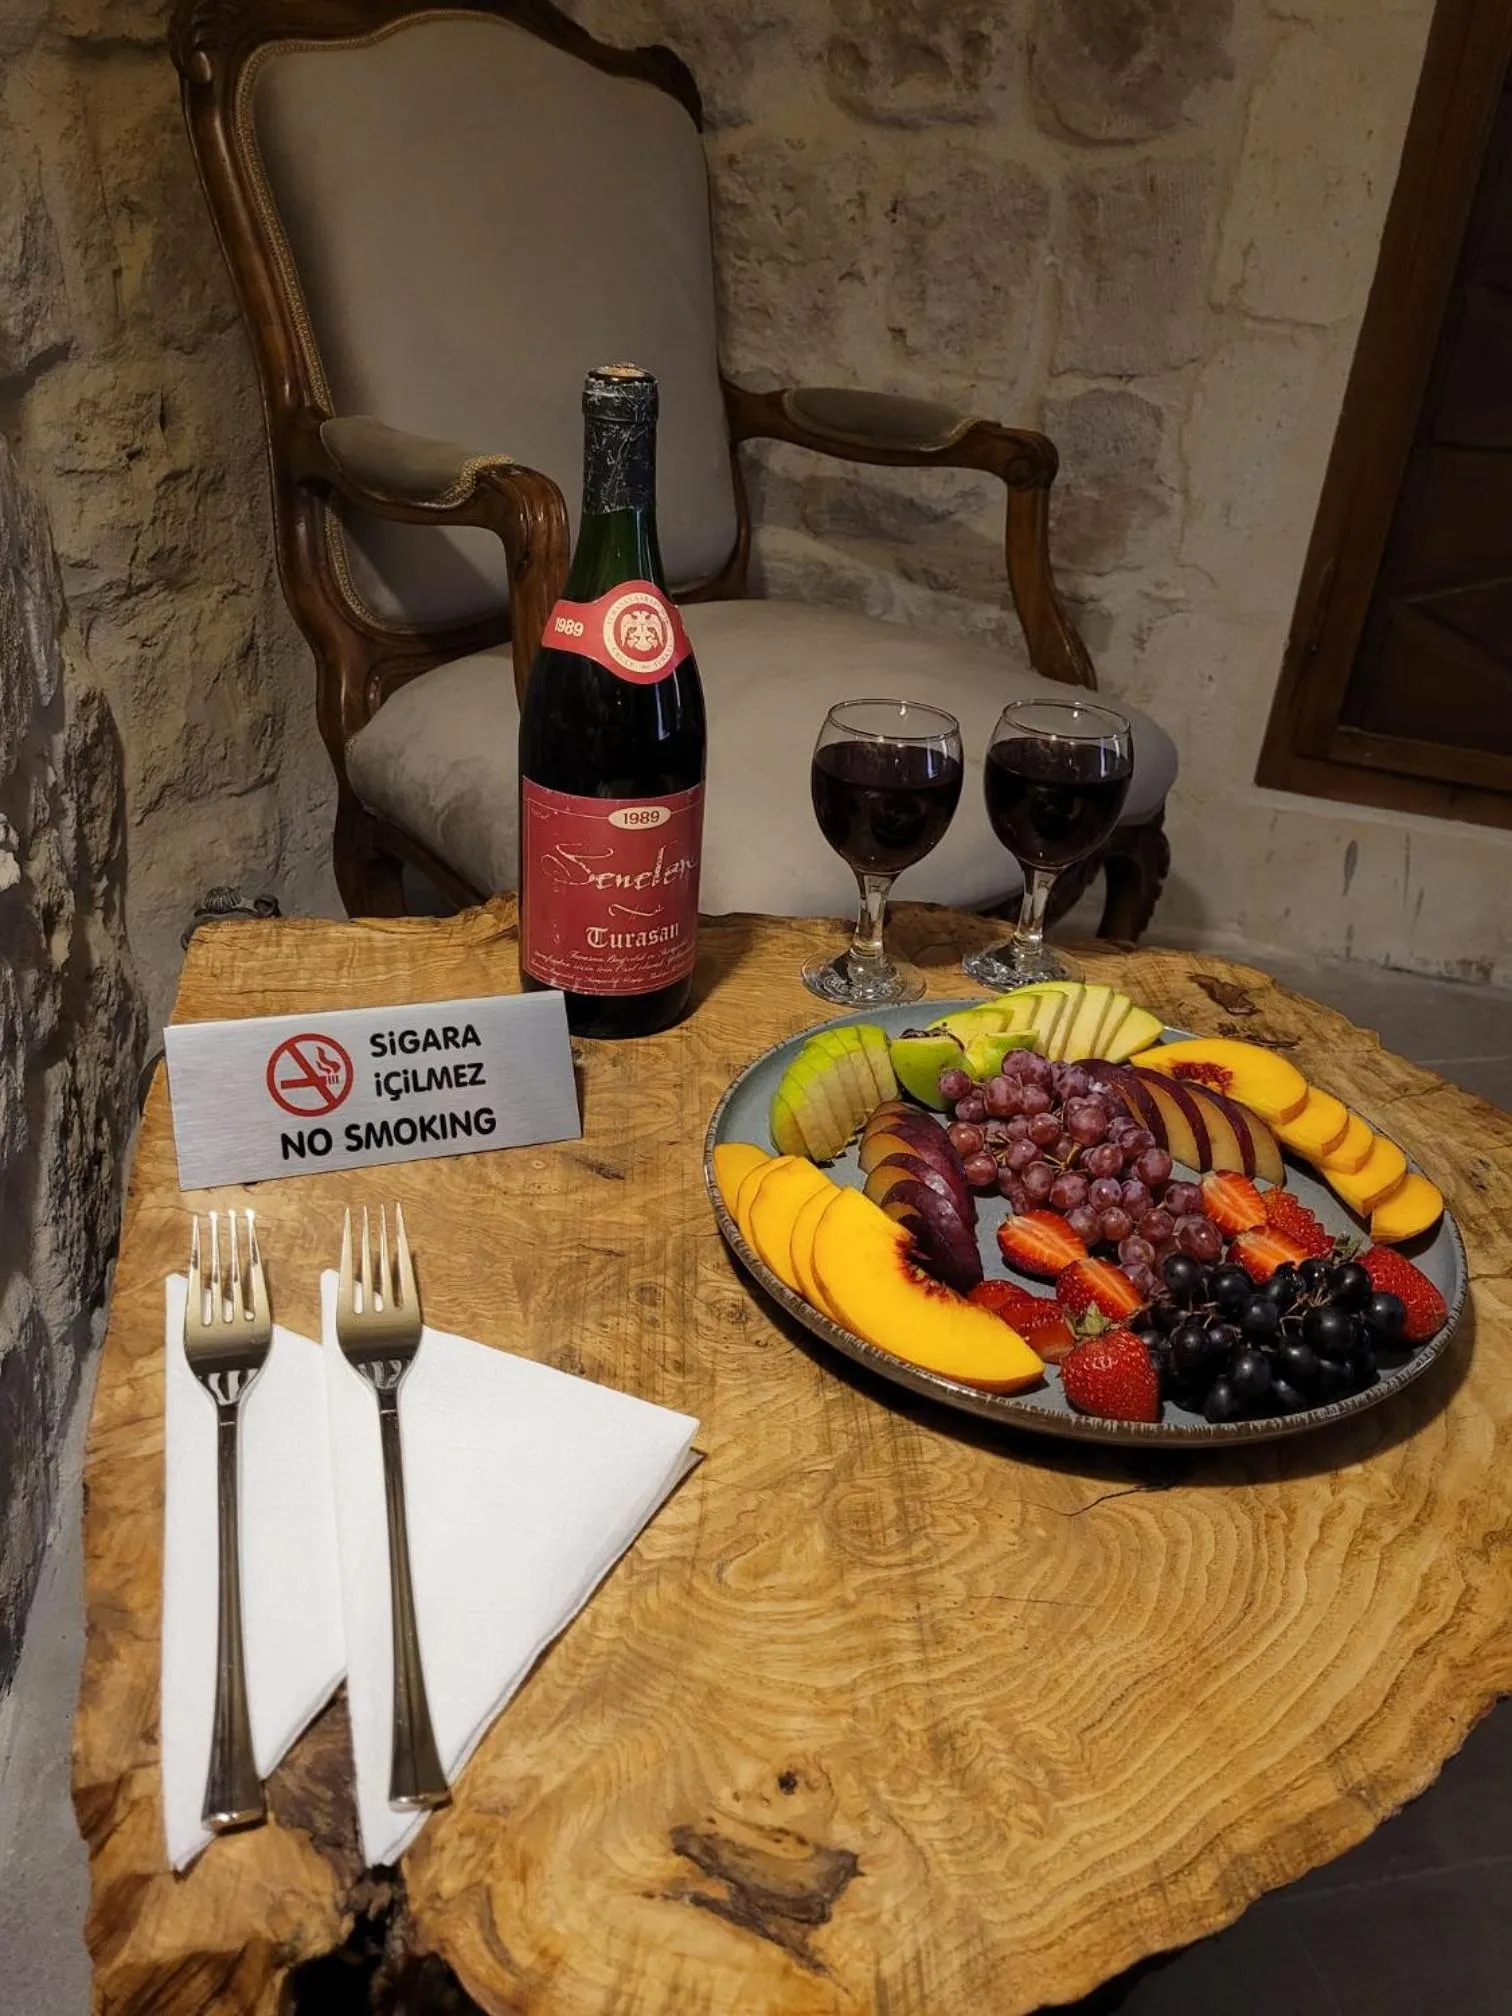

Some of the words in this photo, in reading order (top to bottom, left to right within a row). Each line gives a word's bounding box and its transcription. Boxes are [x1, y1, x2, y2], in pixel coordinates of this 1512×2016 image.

[554, 617, 584, 637] 1989
[623, 811, 660, 825] 1989
[586, 921, 680, 949] Turasan
[280, 1126, 334, 1161] NO
[344, 1107, 497, 1153] SMOKING
